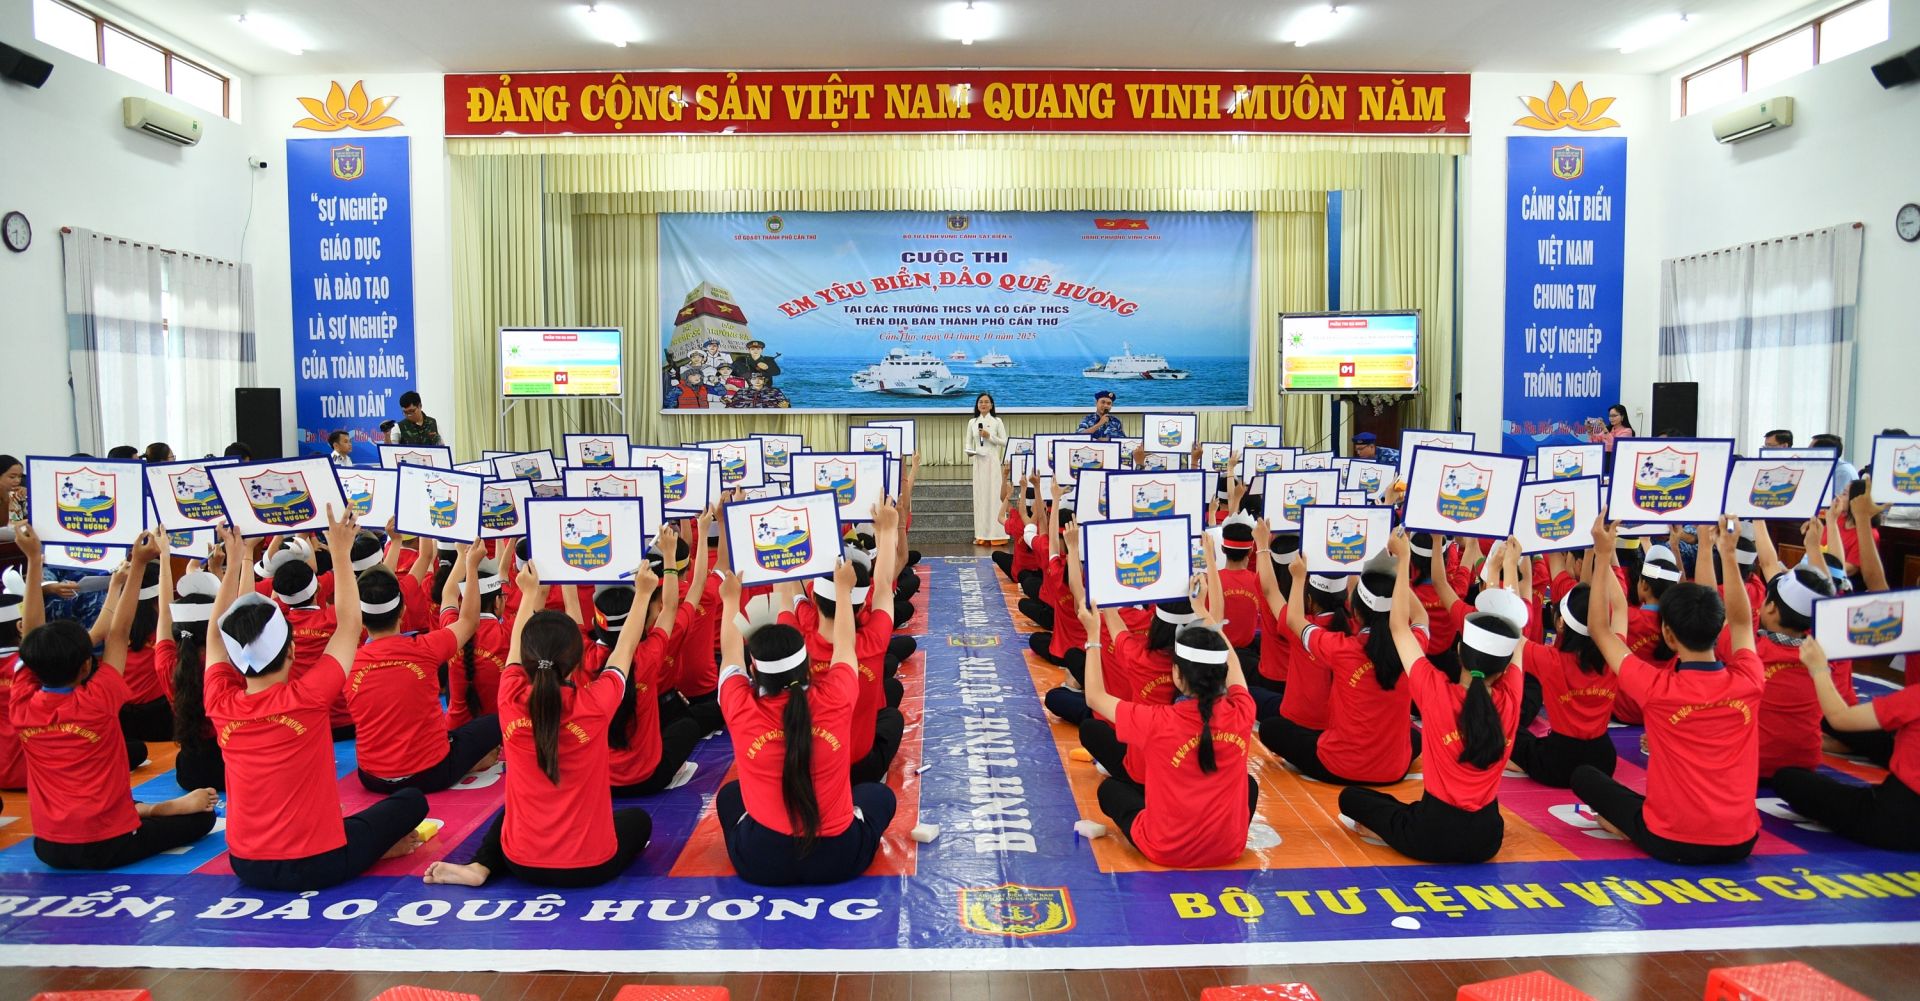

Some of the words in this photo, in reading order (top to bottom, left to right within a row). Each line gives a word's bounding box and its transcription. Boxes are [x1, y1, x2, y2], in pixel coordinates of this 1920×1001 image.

[468, 75, 570, 122] ĐẢNG
[580, 73, 683, 129] CỘNG
[696, 73, 773, 121] SẢN
[782, 73, 874, 128] VIỆT
[885, 84, 970, 119] NAM
[983, 82, 1115, 119] QUANG
[1125, 83, 1222, 119] VINH
[1233, 74, 1346, 120] MUÔN
[1359, 78, 1446, 121] NĂM
[340, 194, 388, 225] NGHIỆP
[1521, 186, 1554, 221] CẢNH
[1558, 189, 1580, 221] SÁT
[1583, 185, 1611, 221] BIỂN
[320, 234, 350, 261] GIÁO
[355, 237, 380, 265] DỤC
[901, 250, 964, 265] CUỘC
[972, 252, 1008, 263] THI
[1538, 235, 1563, 270] VIỆT
[1566, 239, 1593, 265] NAM
[314, 273, 332, 300] VÀ
[334, 273, 361, 299] ĐÀO
[364, 276, 390, 304] TẠO
[778, 295, 817, 317] EM
[815, 282, 866, 304] YÊU
[871, 266, 940, 293] BIỂN,
[940, 266, 992, 285] ĐẢO
[999, 274, 1051, 292] QUÊ
[1053, 282, 1138, 315] HƯƠNG
[1533, 284, 1573, 310] CHUNG
[1577, 284, 1596, 310] TAY
[844, 306, 861, 314] TẠI
[865, 304, 888, 313] CÁC
[893, 304, 938, 313] TRƯỜNG
[976, 304, 990, 313] VÀ
[994, 304, 1009, 313] CÓ
[1013, 303, 1036, 313] CẤP
[855, 316, 884, 325] TRÊN
[889, 318, 908, 327] ĐỊA
[911, 316, 936, 325] BÀN
[940, 316, 977, 325] THÀNH
[982, 316, 1005, 325] PHỐ
[1009, 316, 1032, 325] CẦN
[309, 312, 326, 340] LÀ
[329, 315, 347, 344] SỰ
[349, 311, 397, 343] NGHIỆP
[1525, 323, 1537, 354] VÌ
[1540, 326, 1557, 359] SỰ
[1559, 323, 1602, 359] NGHIỆP
[302, 349, 328, 380] CỦA
[330, 351, 365, 379] TOÀN
[368, 348, 408, 381] ĐẢNG,
[556, 374, 566, 382] 01
[1341, 365, 1353, 373] 01
[1524, 364, 1562, 398] TRỒNG
[1565, 366, 1601, 398] NGƯỜI
[320, 391, 354, 418] TOÀN
[958, 656, 999, 681] TIN
[949, 716, 1019, 771] TĨNH
[955, 777, 1037, 854] BÌNH
[196, 890, 379, 920] ĐẢO
[389, 894, 565, 925] QUÊ
[578, 895, 885, 922] HƯƠNG
[1169, 886, 1265, 923] BỘ
[1275, 886, 1367, 916] TƯ
[1375, 881, 1565, 918] LỆNH
[1560, 876, 1763, 907] VÙNG
[1755, 867, 1920, 900] CẢNH
